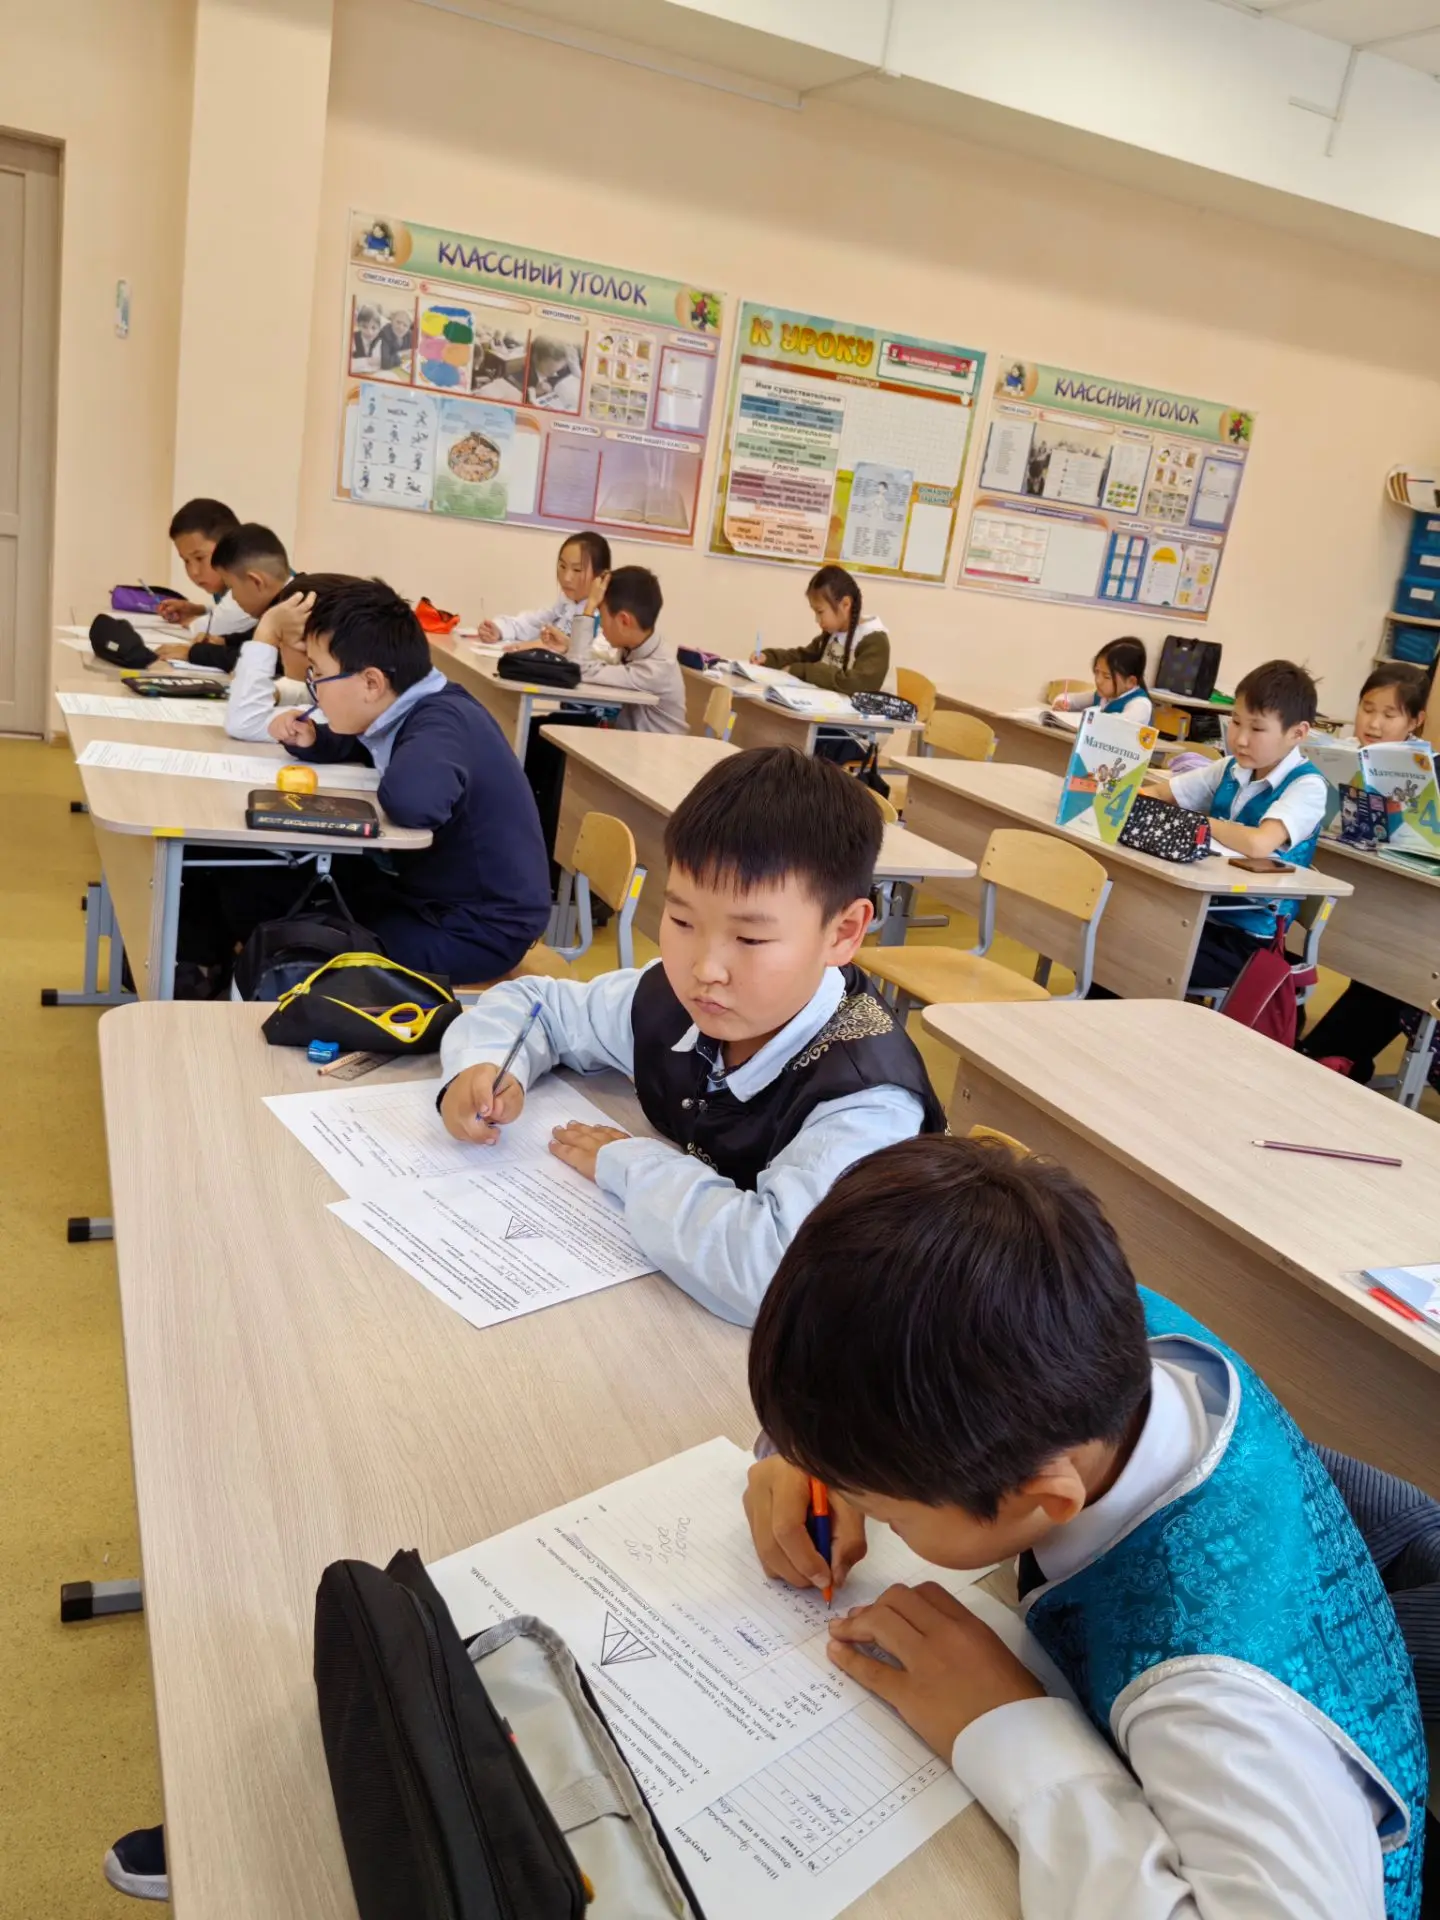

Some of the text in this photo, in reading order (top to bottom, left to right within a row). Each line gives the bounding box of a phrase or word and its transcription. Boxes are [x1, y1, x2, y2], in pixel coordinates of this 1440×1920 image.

[438, 240, 649, 307] КЛАССНЫЙ УГОЛОК
[750, 316, 774, 347] К
[780, 323, 876, 367] УРОКУ
[1054, 377, 1200, 425] КЛАССНЫЙ УГОЛОК
[1084, 735, 1141, 761] Математика
[1368, 768, 1426, 781] Математика
[1104, 784, 1134, 827] 4
[1419, 799, 1440, 834] 4
[778, 1833, 805, 1858] Ответ
